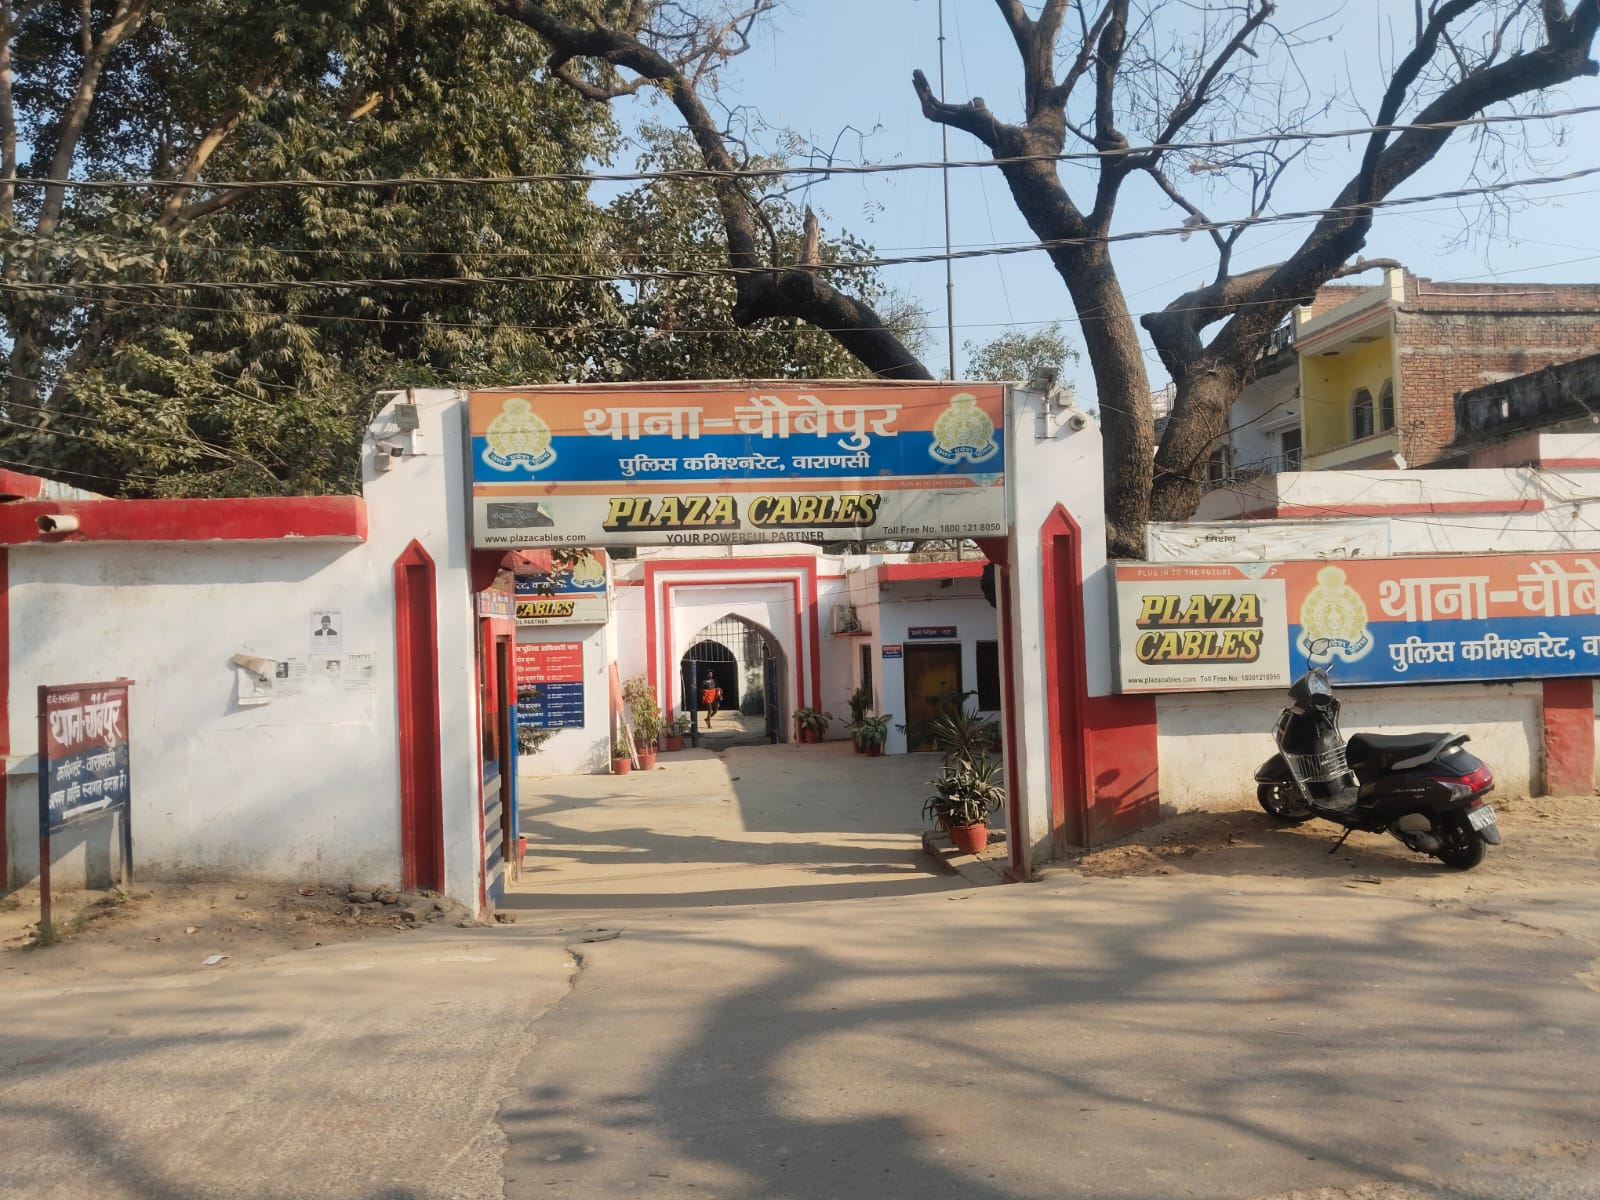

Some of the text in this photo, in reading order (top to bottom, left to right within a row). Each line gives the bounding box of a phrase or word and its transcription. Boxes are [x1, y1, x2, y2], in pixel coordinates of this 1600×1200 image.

[619, 453, 679, 477] पुलिस
[791, 450, 871, 469] वाराणसी
[602, 494, 881, 532] PLAZA CABLES
[666, 531, 825, 544] YOUR POWERFUL PARTNER
[883, 523, 1001, 535] Toll Free No. 1800 121 8050
[485, 534, 586, 544] www.plazacables.com
[1160, 569, 1169, 577] IN
[1171, 569, 1181, 577] TO
[1184, 569, 1199, 577] THE
[515, 601, 574, 618] CABLES
[1136, 594, 1263, 630] PLAZA
[1136, 629, 1264, 665] CABLES
[1388, 636, 1455, 672] पुलिस
[1128, 676, 1197, 685] www.plazacables.com
[1200, 675, 1212, 683] Toll
[1213, 675, 1227, 683] Free
